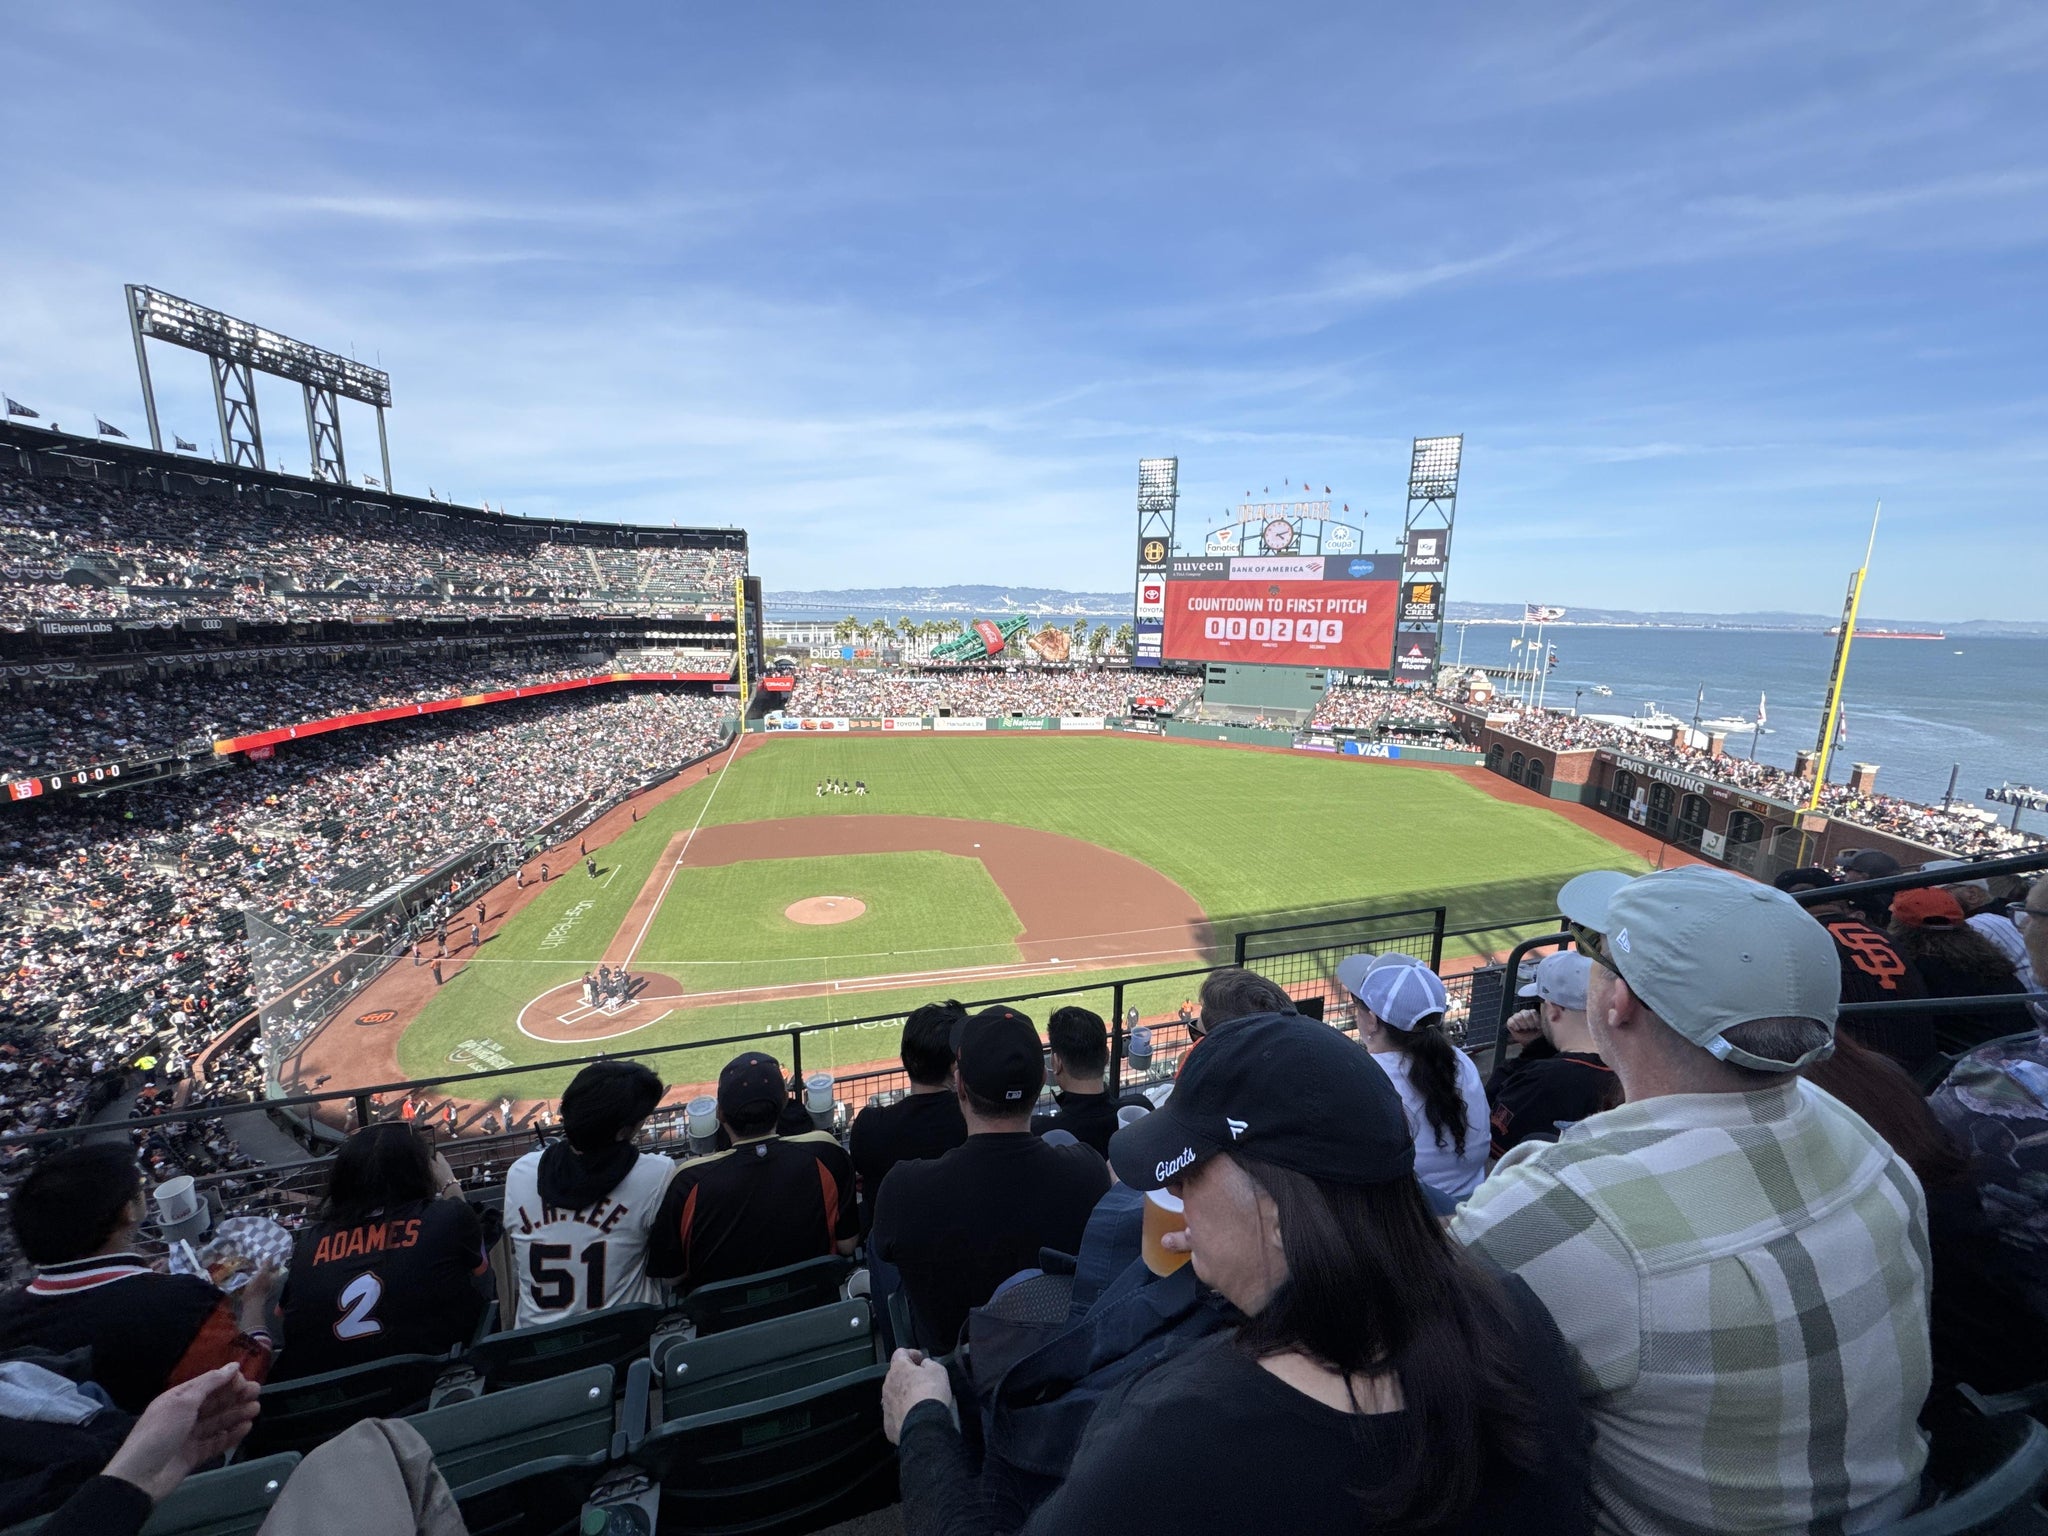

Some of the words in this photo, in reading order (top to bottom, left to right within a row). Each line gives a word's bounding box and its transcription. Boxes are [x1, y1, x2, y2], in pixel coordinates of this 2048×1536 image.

[1236, 503, 1289, 524] ORACLE
[1294, 501, 1331, 521] PARK
[1327, 540, 1352, 549] coupa
[1173, 562, 1223, 571] nuveen
[1267, 565, 1304, 573] AMERICA
[1410, 556, 1440, 566] Health
[1187, 597, 1263, 612] COUNTDOWN
[1267, 598, 1280, 612] TO
[1286, 598, 1323, 614] FIRST
[1326, 599, 1367, 614] PITCH
[810, 646, 841, 660] blue
[1398, 656, 1431, 665] Benjamin
[1402, 663, 1426, 671] Moore
[1012, 718, 1044, 727] National
[1356, 743, 1390, 758] VISA
[51, 777, 61, 790] 0
[78, 771, 87, 784] 0
[94, 768, 104, 780] 0
[111, 764, 120, 777] 0
[1647, 766, 1705, 795] LANDING
[1985, 788, 2038, 810] BANK
[537, 916, 584, 951] Health
[1827, 922, 1906, 990] SF
[1155, 1147, 1196, 1182] Giants
[312, 1218, 422, 1267] ADAMES
[529, 1240, 607, 1310] 51
[333, 1270, 384, 1341] 2
